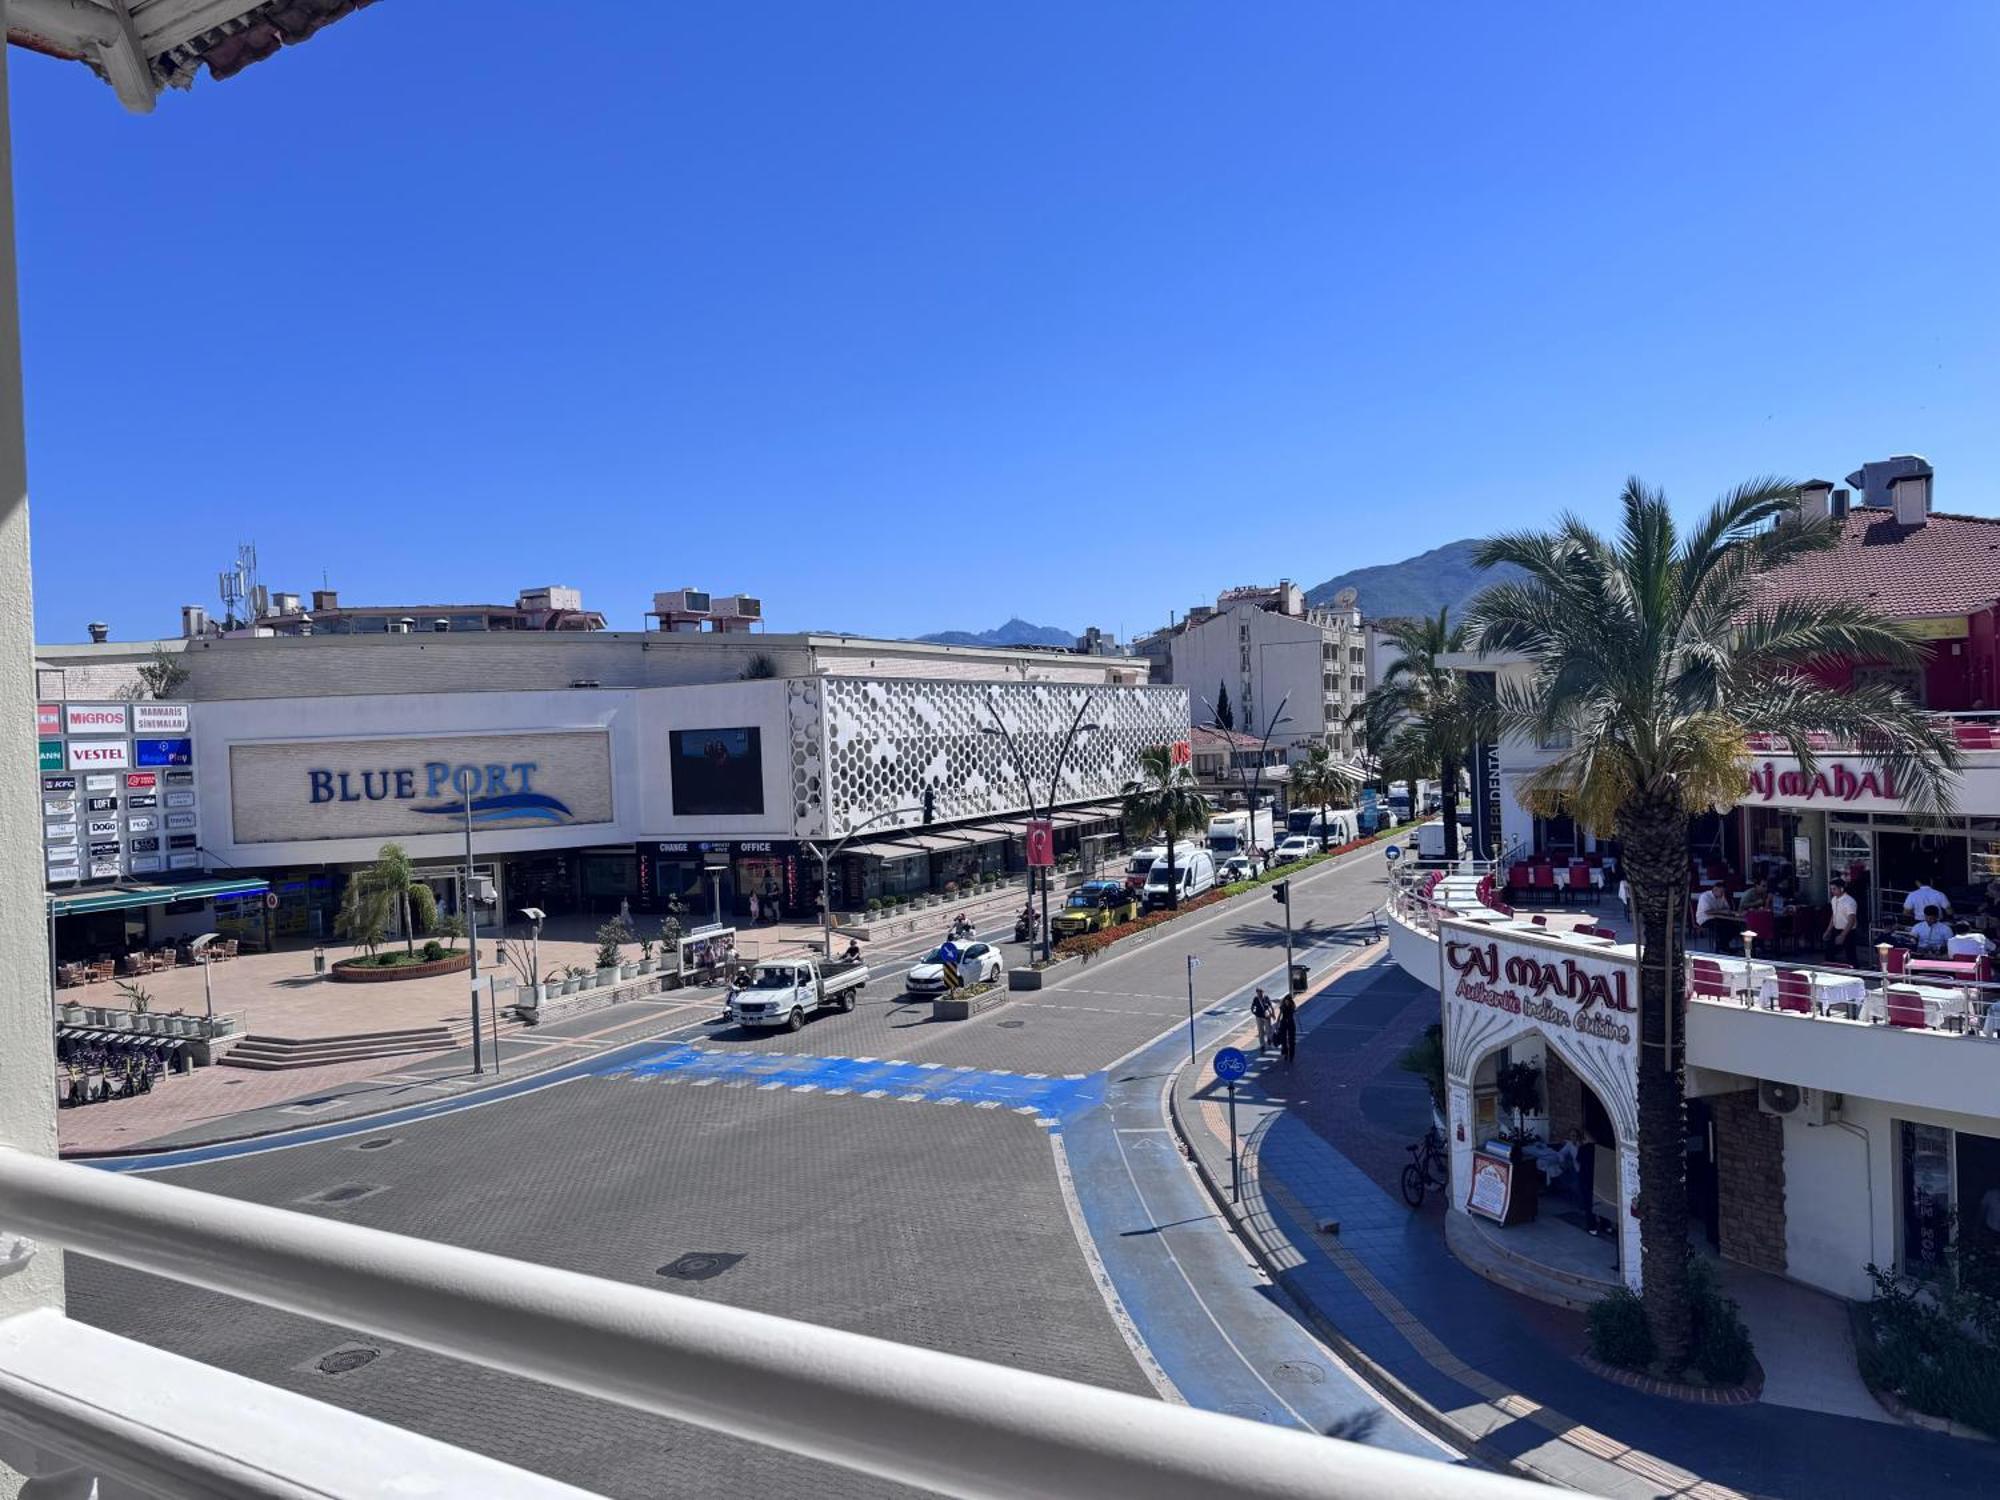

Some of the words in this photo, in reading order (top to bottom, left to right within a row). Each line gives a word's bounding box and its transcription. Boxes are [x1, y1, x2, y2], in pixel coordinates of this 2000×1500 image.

[73, 749, 125, 760] VESTEL
[54, 780, 74, 788] KFC
[307, 770, 415, 803] BLUE
[424, 761, 537, 797] PORT
[94, 799, 110, 809] LOFT
[92, 823, 115, 831] DOGO
[660, 843, 688, 852] CHANGE
[740, 842, 772, 852] OFFICE
[1456, 979, 1521, 1015] Authentic
[1573, 1009, 1631, 1045] Cuisine
